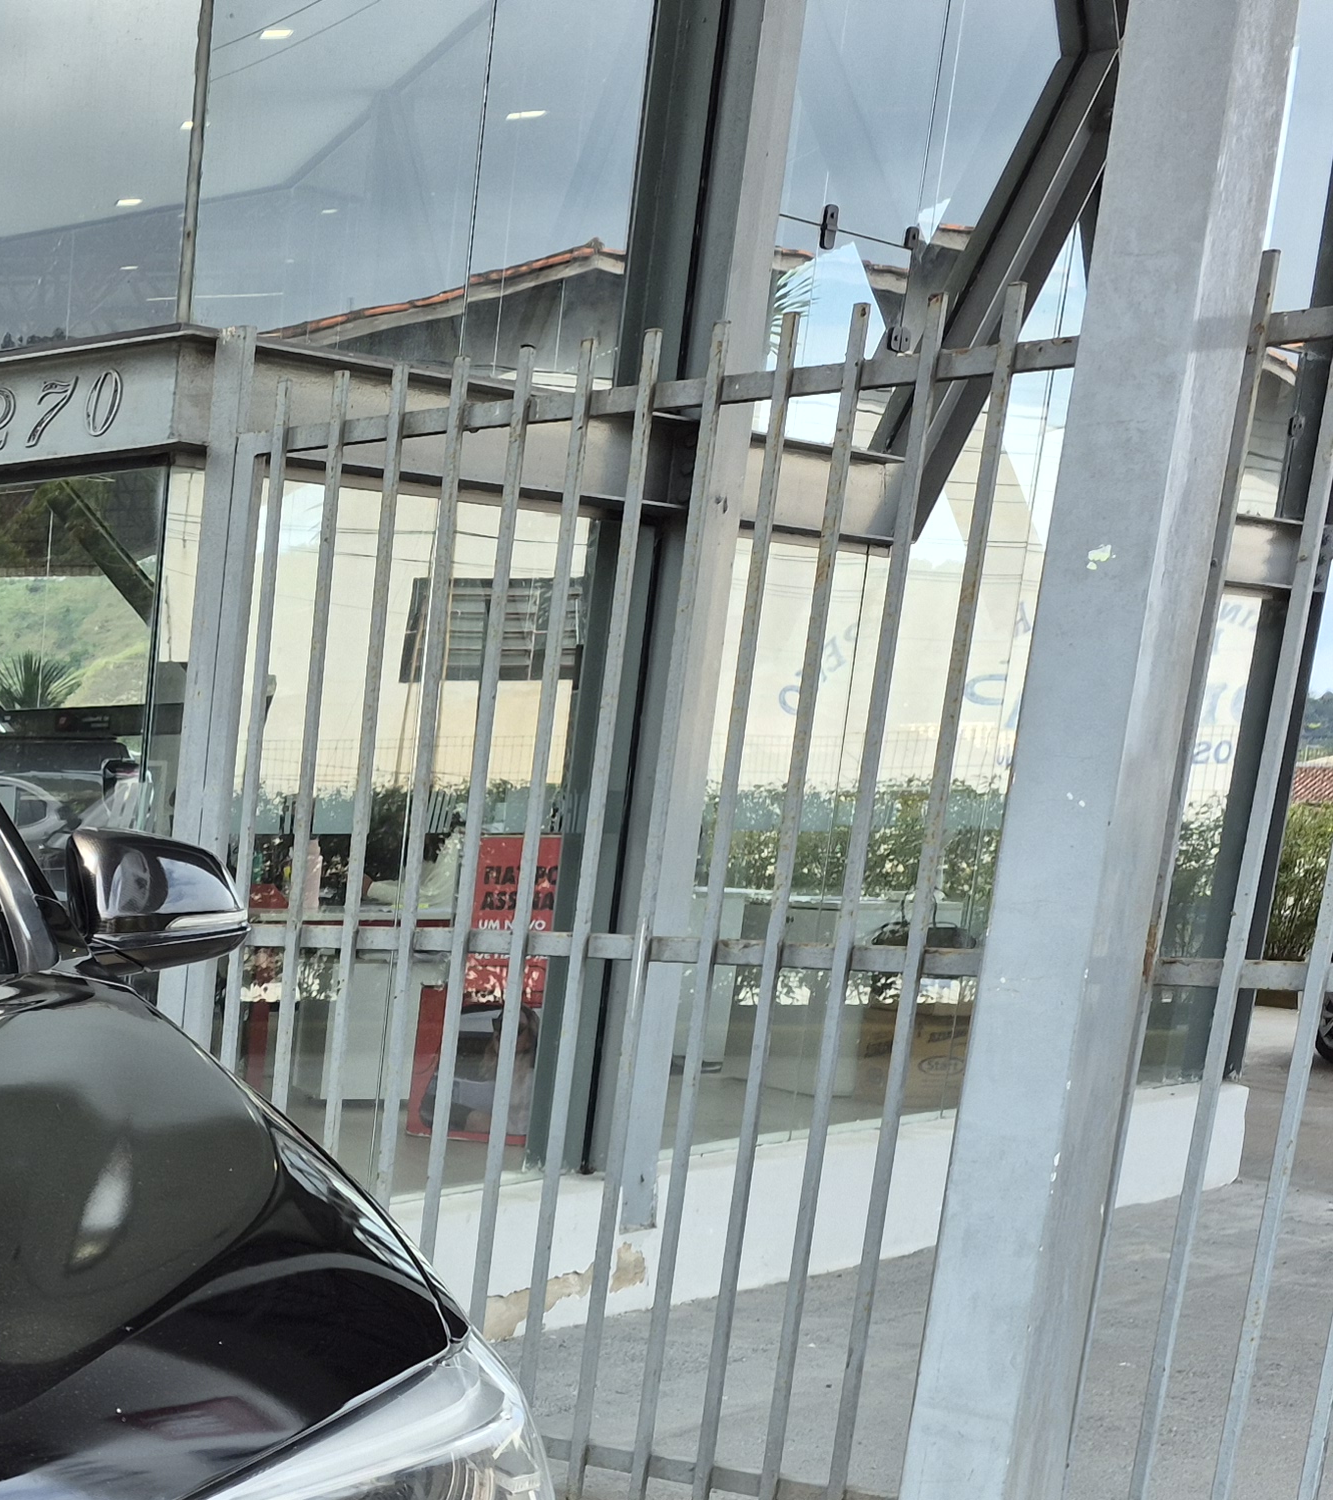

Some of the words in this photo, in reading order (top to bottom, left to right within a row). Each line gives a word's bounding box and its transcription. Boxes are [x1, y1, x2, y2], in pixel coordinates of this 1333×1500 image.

[484, 866, 521, 885] FIA
[478, 919, 500, 930] UM
[504, 919, 546, 931] NVO
